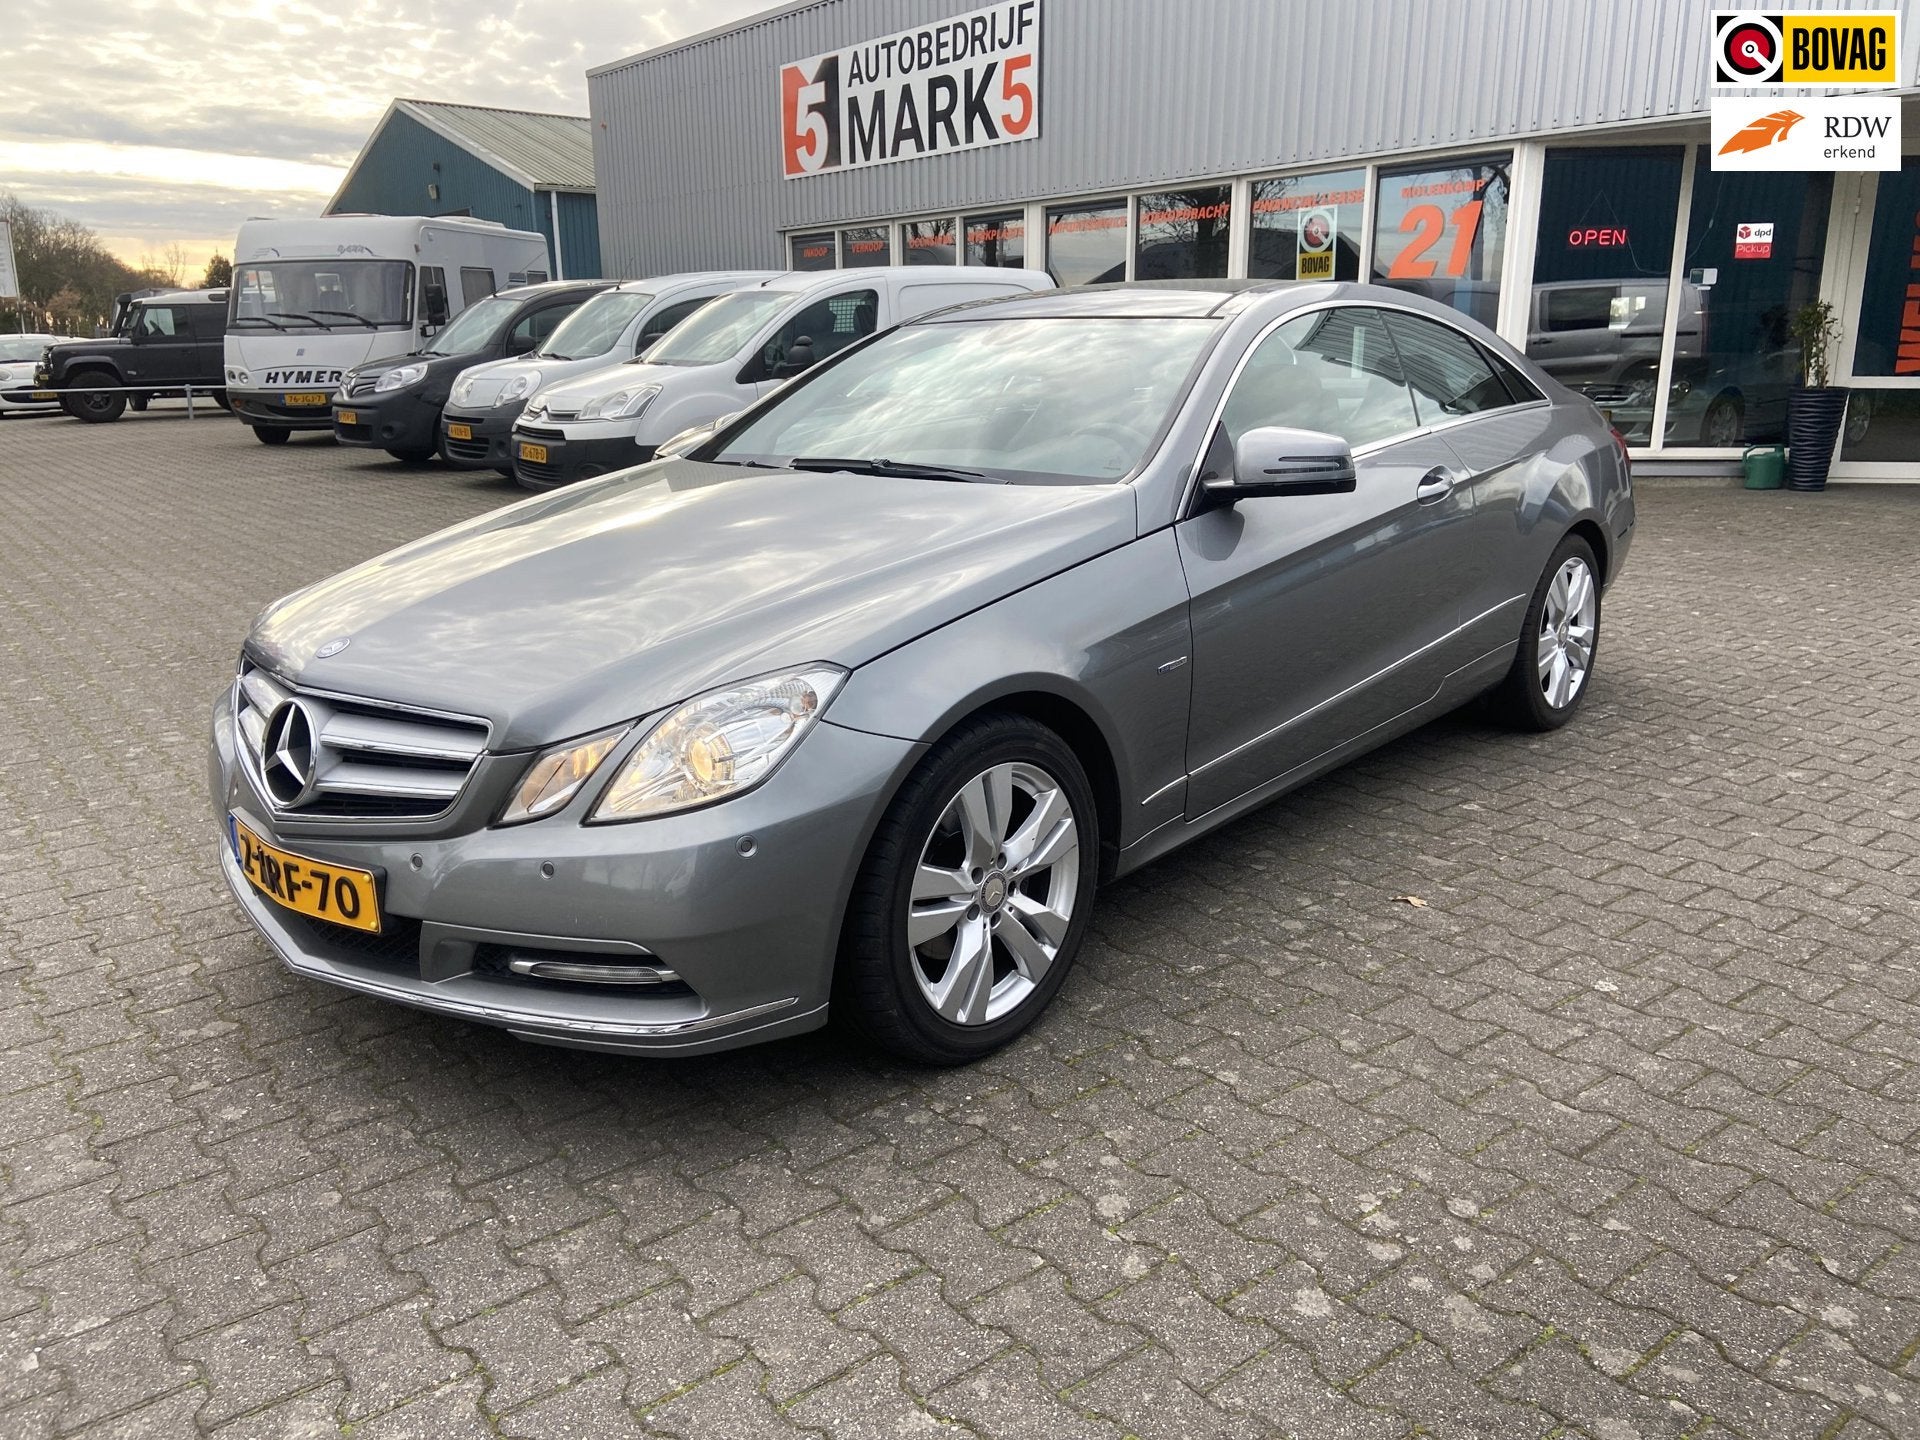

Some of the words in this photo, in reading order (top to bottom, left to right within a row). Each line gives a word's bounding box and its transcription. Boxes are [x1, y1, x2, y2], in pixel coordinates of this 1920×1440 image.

[847, 2, 1035, 88] AUTOBEDRIJF
[847, 53, 1033, 165] MARK5
[1387, 199, 1484, 280] 21
[1569, 229, 1627, 246] OPEN
[1754, 228, 1772, 238] dpd
[803, 247, 828, 258] INKOOP
[851, 241, 884, 254] VERKOOP
[1736, 244, 1770, 254] Pickup
[1301, 255, 1330, 274] BOVAG
[265, 371, 342, 384] HYMER
